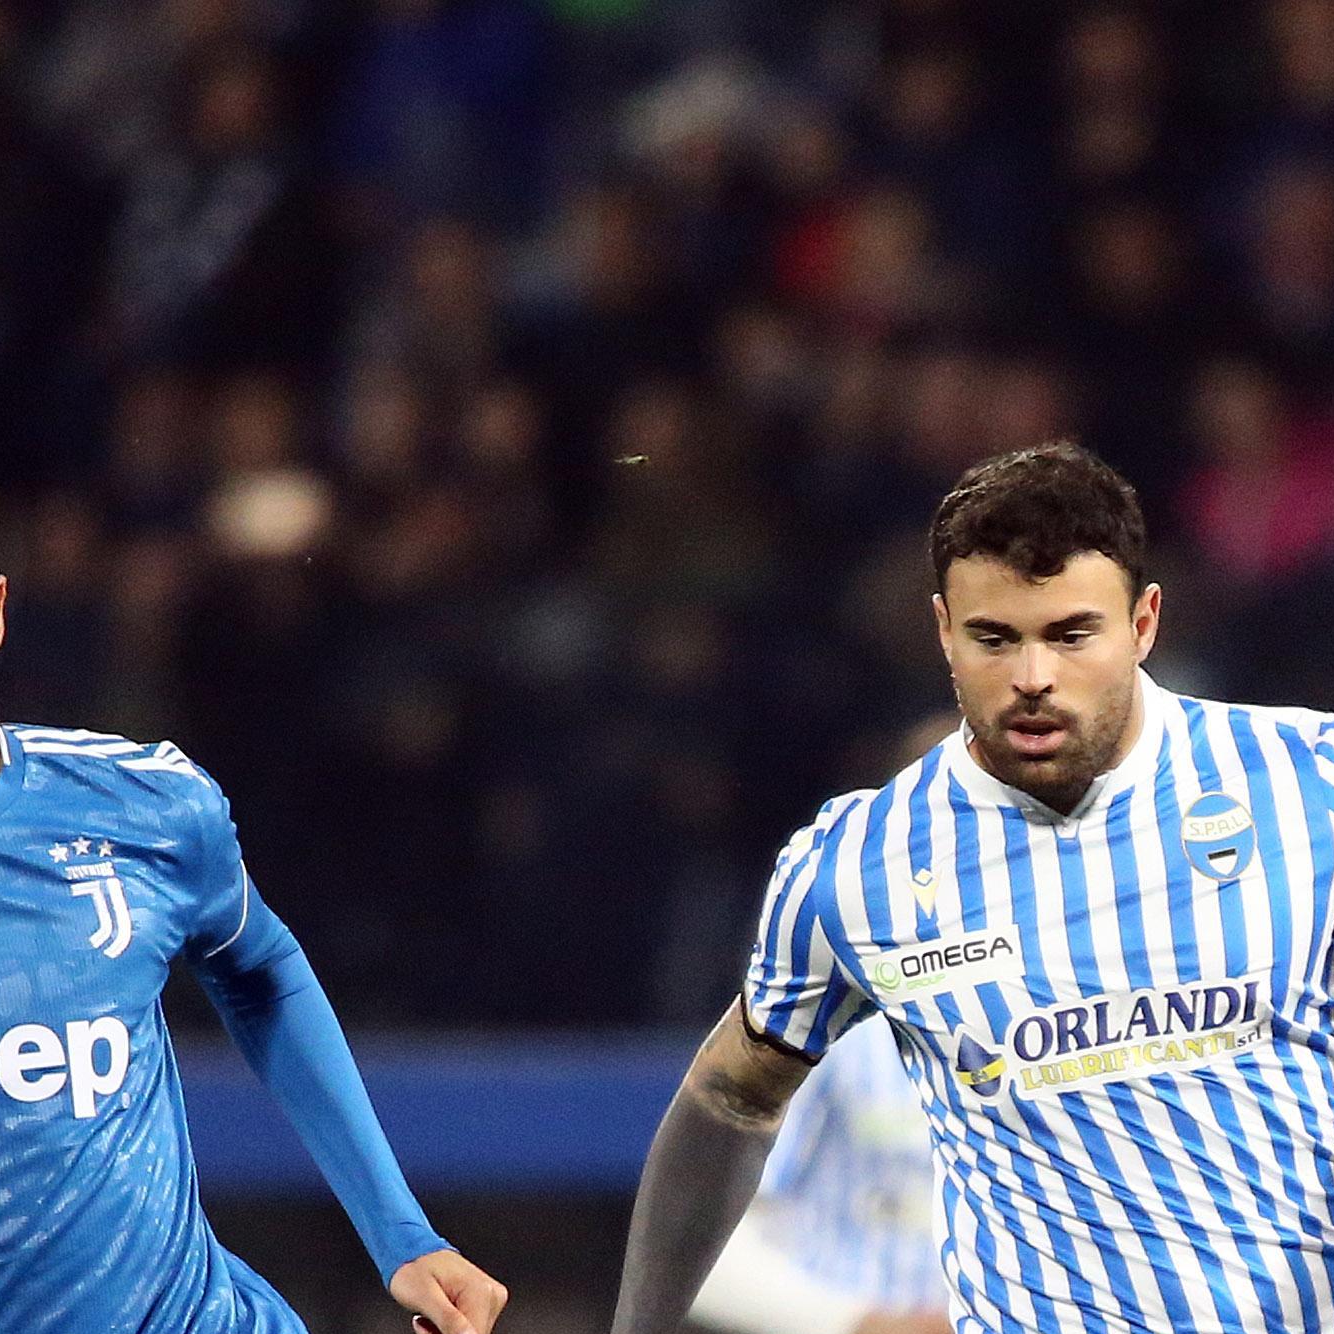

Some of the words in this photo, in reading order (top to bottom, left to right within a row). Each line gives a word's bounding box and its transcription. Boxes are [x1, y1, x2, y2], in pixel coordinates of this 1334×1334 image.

[901, 936, 1014, 978] OMEGA
[1013, 980, 1260, 1062] ORLANDI
[1020, 1031, 1237, 1092] LUBRIFICANTI
[1237, 1024, 1262, 1047] srl
